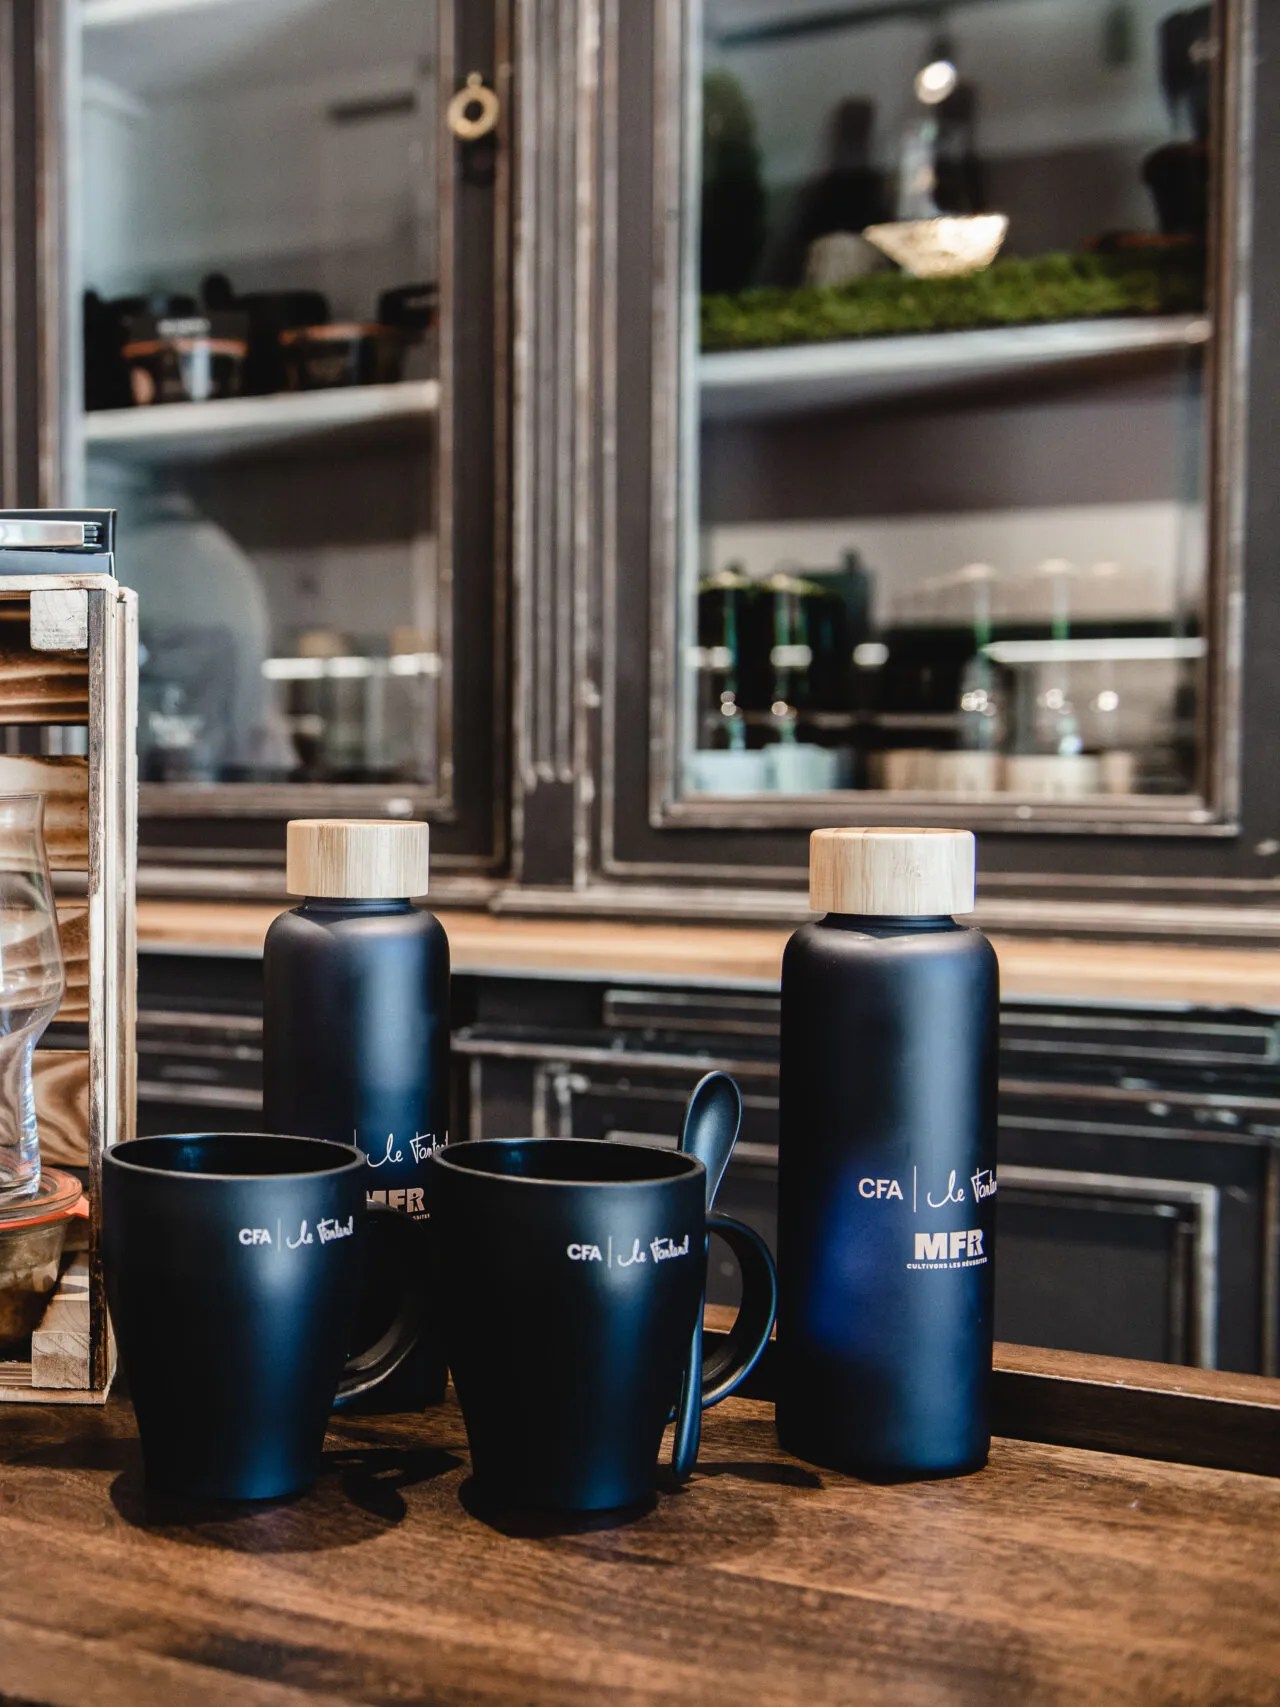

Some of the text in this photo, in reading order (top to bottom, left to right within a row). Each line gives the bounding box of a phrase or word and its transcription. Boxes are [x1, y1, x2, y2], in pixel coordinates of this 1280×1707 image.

[857, 1177, 904, 1200] CFA
[238, 1227, 272, 1246] CFA
[914, 1229, 984, 1260] MFR
[566, 1243, 602, 1262] CFA
[906, 1262, 948, 1270] CULTIVONS
[949, 1261, 961, 1269] LES
